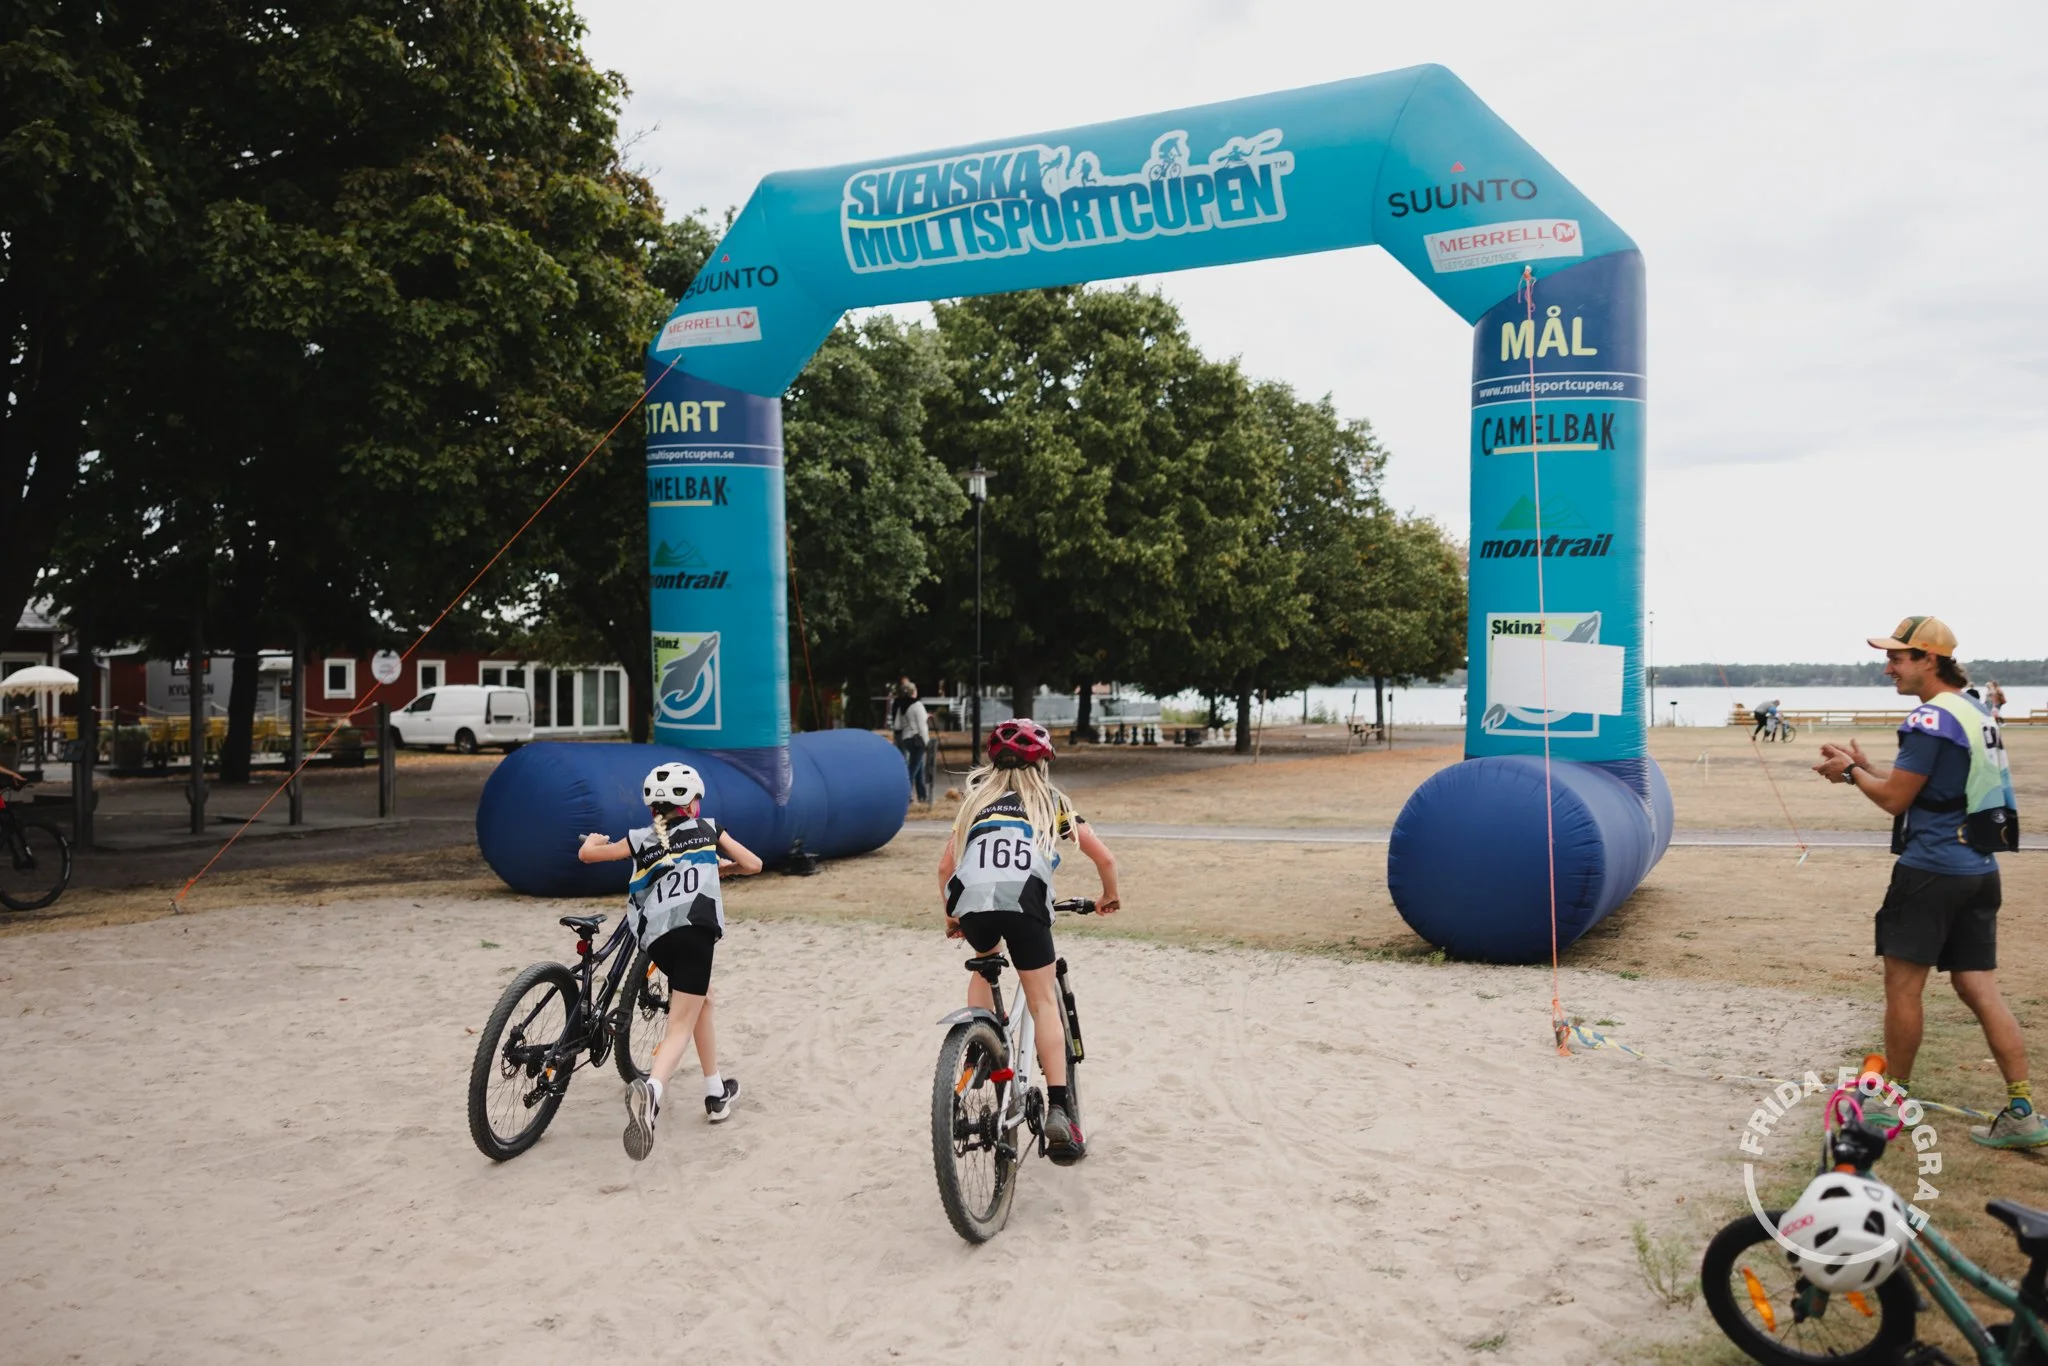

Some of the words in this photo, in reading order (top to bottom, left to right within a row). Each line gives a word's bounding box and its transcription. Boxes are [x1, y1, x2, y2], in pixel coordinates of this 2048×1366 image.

[848, 150, 1042, 219] SVENSKA
[1387, 178, 1538, 218] SUUNTO
[848, 164, 1278, 269] MULTISPORTCUPEN
[1439, 226, 1552, 253] MERRELL
[667, 316, 736, 334] MERRELL
[1501, 305, 1597, 361] MÅL
[1479, 378, 1625, 398] www.multisportcupen.se
[1481, 412, 1616, 456] CAMELBAK
[1479, 533, 1614, 559] montrail
[1491, 619, 1545, 635] Skinz
[976, 837, 1032, 871] 165
[656, 867, 699, 904] 120
